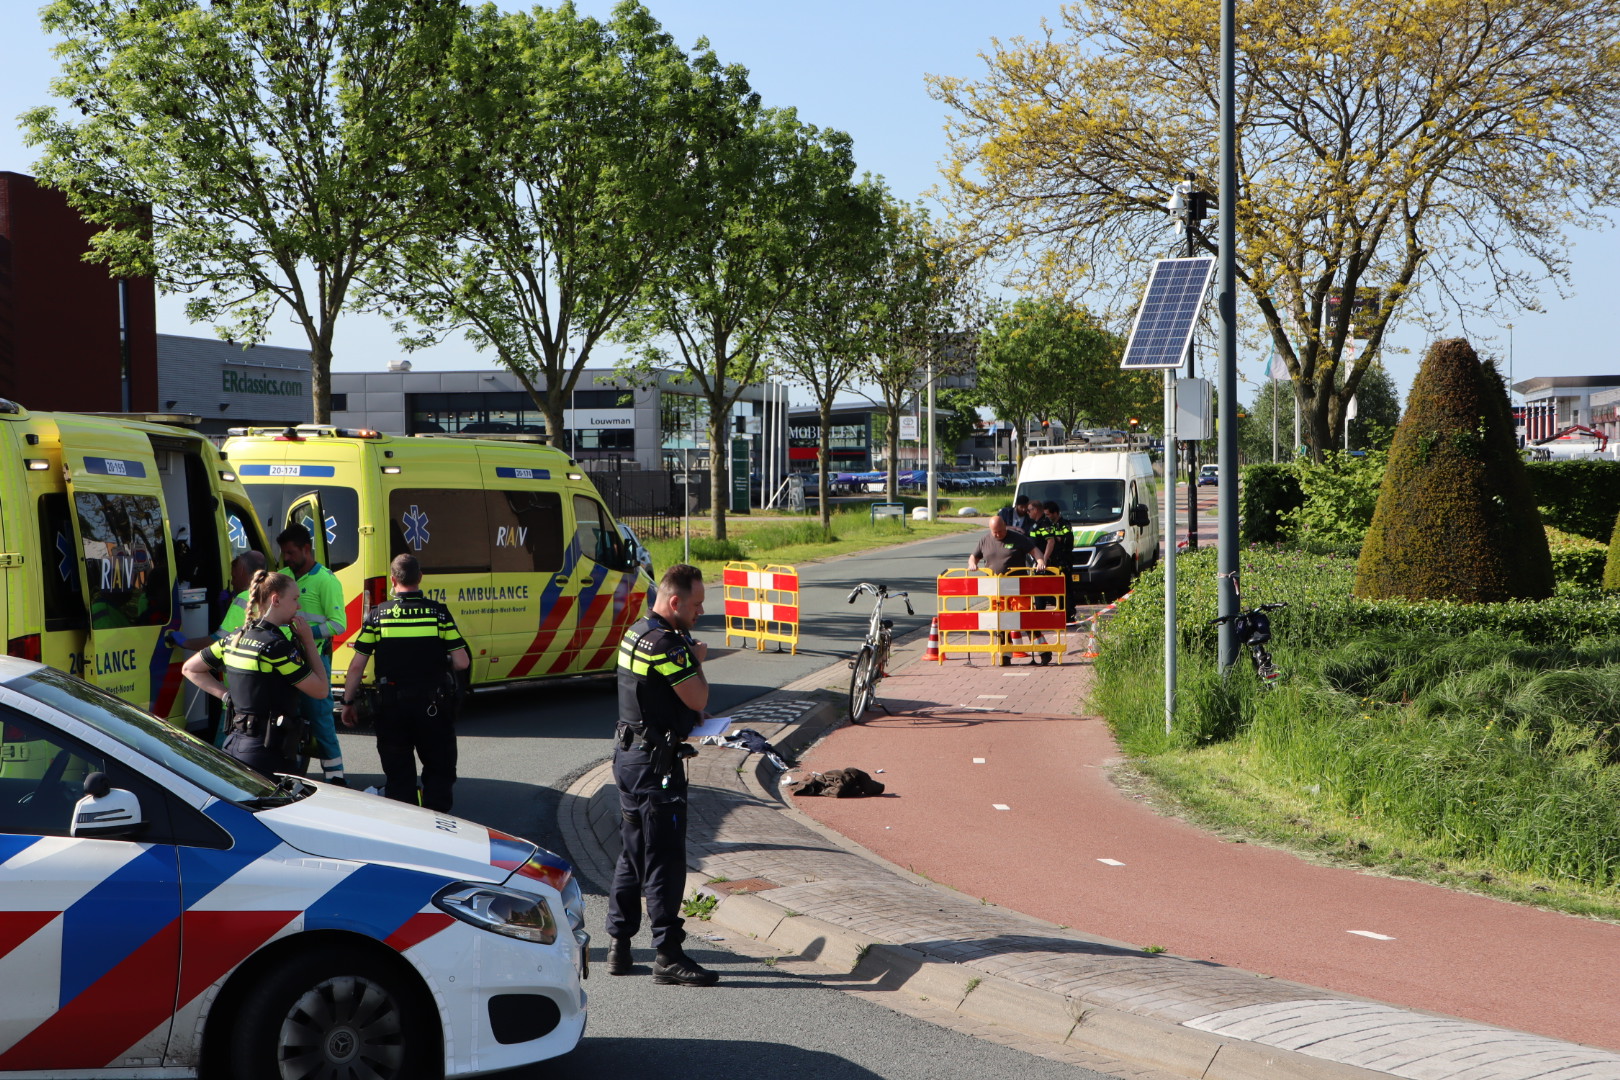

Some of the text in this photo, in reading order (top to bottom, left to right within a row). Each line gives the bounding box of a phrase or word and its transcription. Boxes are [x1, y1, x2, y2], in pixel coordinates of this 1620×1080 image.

[222, 369, 303, 396] ERclassics.com
[590, 417, 631, 425] Louwman
[787, 425, 858, 440] MOBILEN
[271, 466, 298, 475] 20-174
[458, 585, 529, 602] AMBULANCE
[386, 605, 431, 617] POLITIE
[95, 648, 137, 676] LANCE
